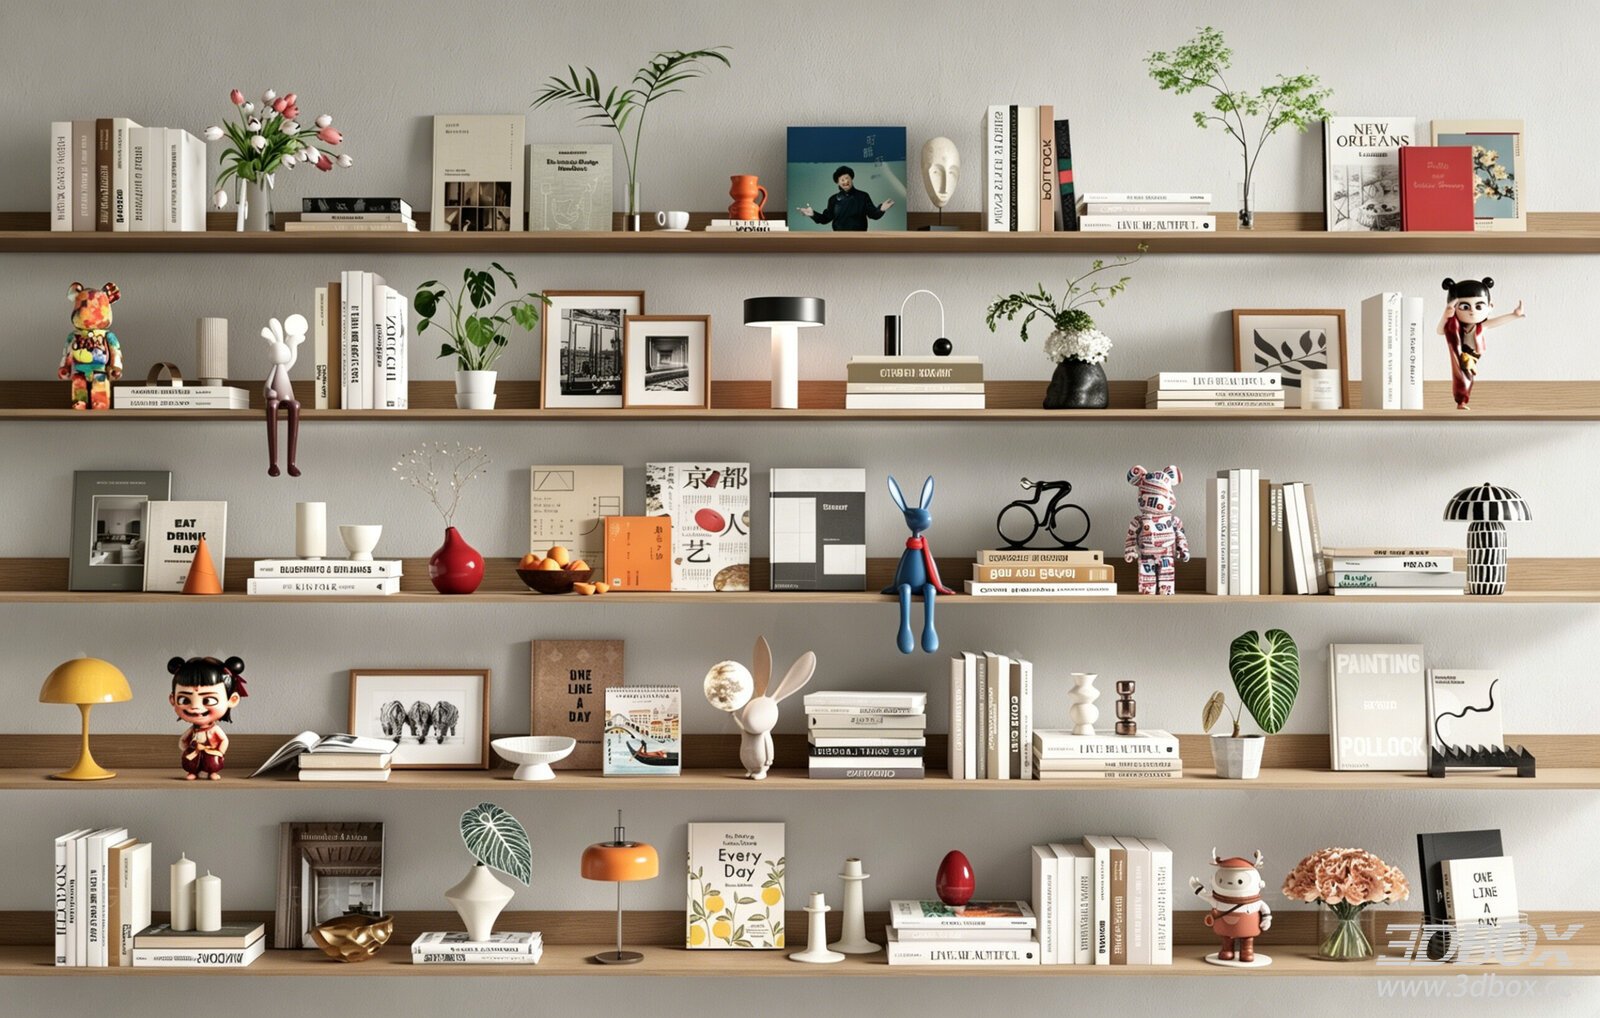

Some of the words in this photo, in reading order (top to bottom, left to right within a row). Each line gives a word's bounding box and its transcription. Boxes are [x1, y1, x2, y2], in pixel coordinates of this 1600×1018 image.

[1353, 123, 1389, 135] NEW
[1336, 135, 1409, 147] ORLEANS
[174, 519, 197, 528] EAT
[719, 513, 748, 538] 人
[166, 532, 206, 541] DRINK
[682, 540, 712, 563] 艺
[1336, 653, 1420, 675] PAINTING
[569, 668, 592, 681] ONE
[568, 683, 593, 695] LINE
[577, 697, 583, 709] A
[569, 711, 591, 723] DAY
[1340, 737, 1426, 757] POLLOCK
[718, 848, 762, 866] Every
[724, 864, 756, 882] Day
[1473, 872, 1493, 882] ONE
